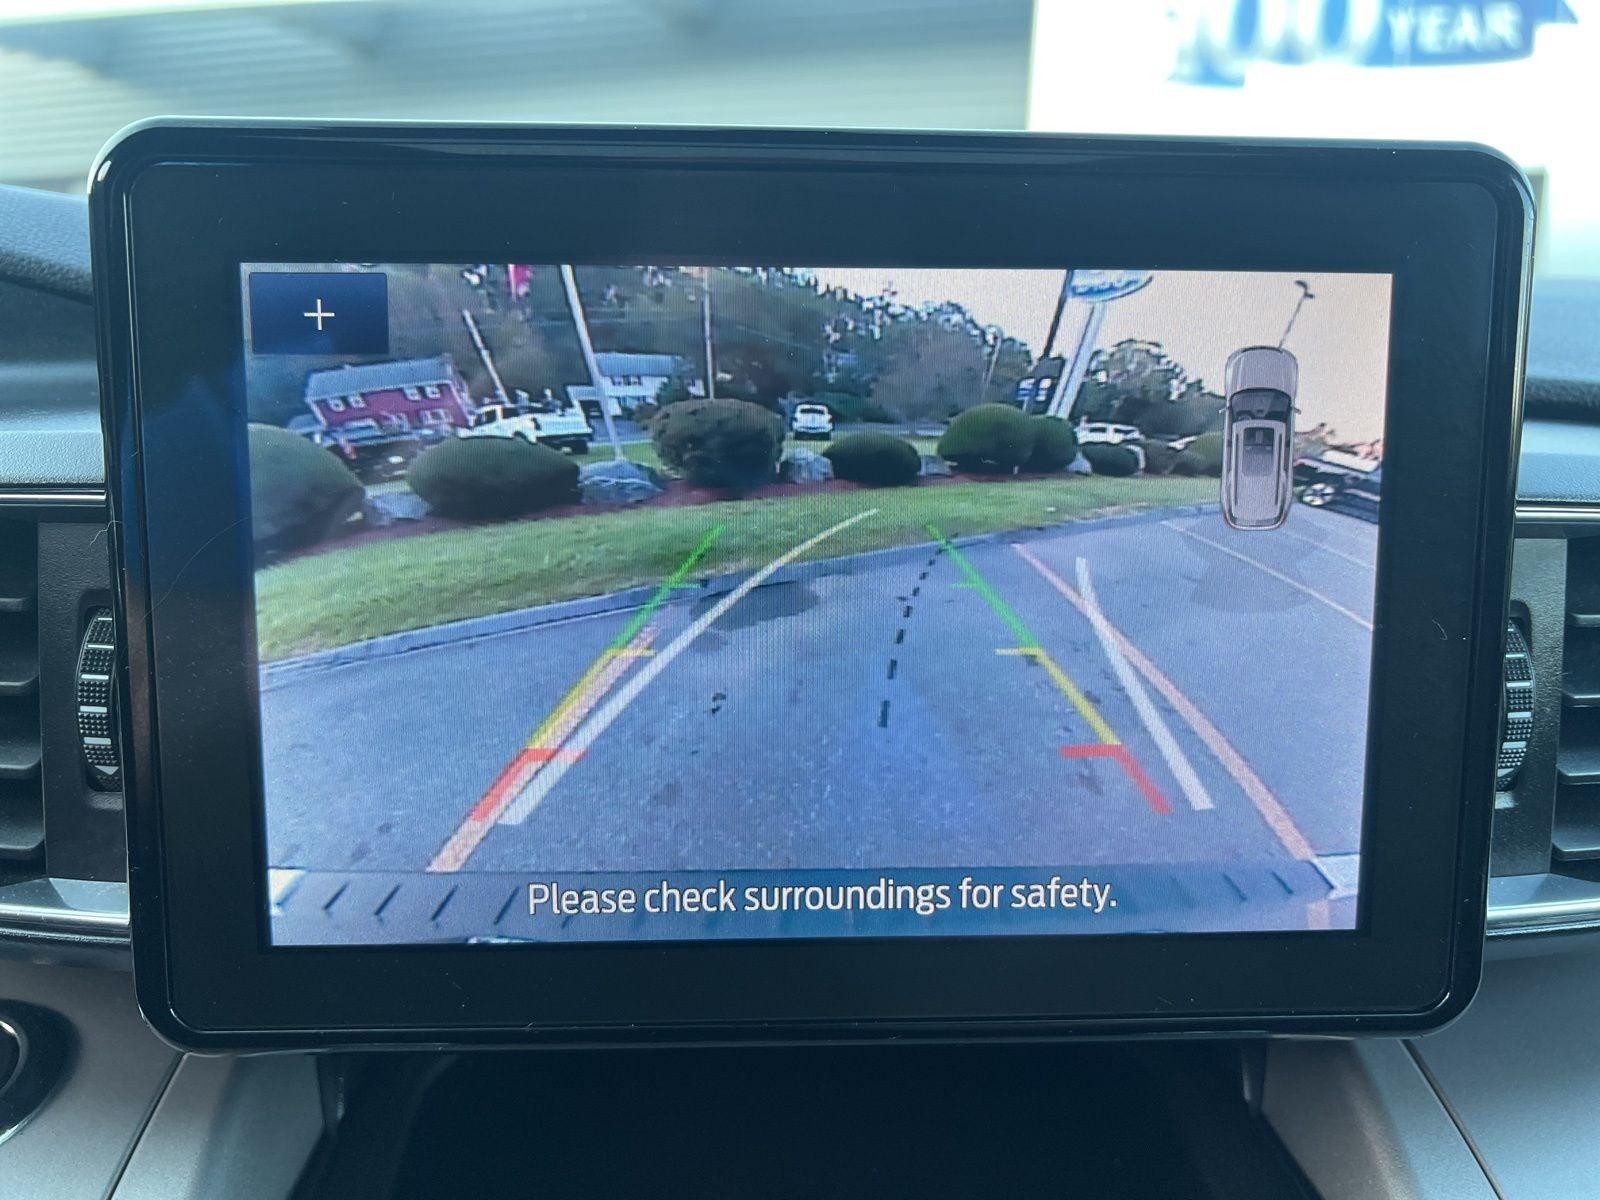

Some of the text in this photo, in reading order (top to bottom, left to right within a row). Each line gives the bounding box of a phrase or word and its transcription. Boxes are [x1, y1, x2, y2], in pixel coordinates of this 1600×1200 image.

[1385, 4, 1523, 54] YEAR
[528, 876, 1118, 915] Please check surroundings for safety.
